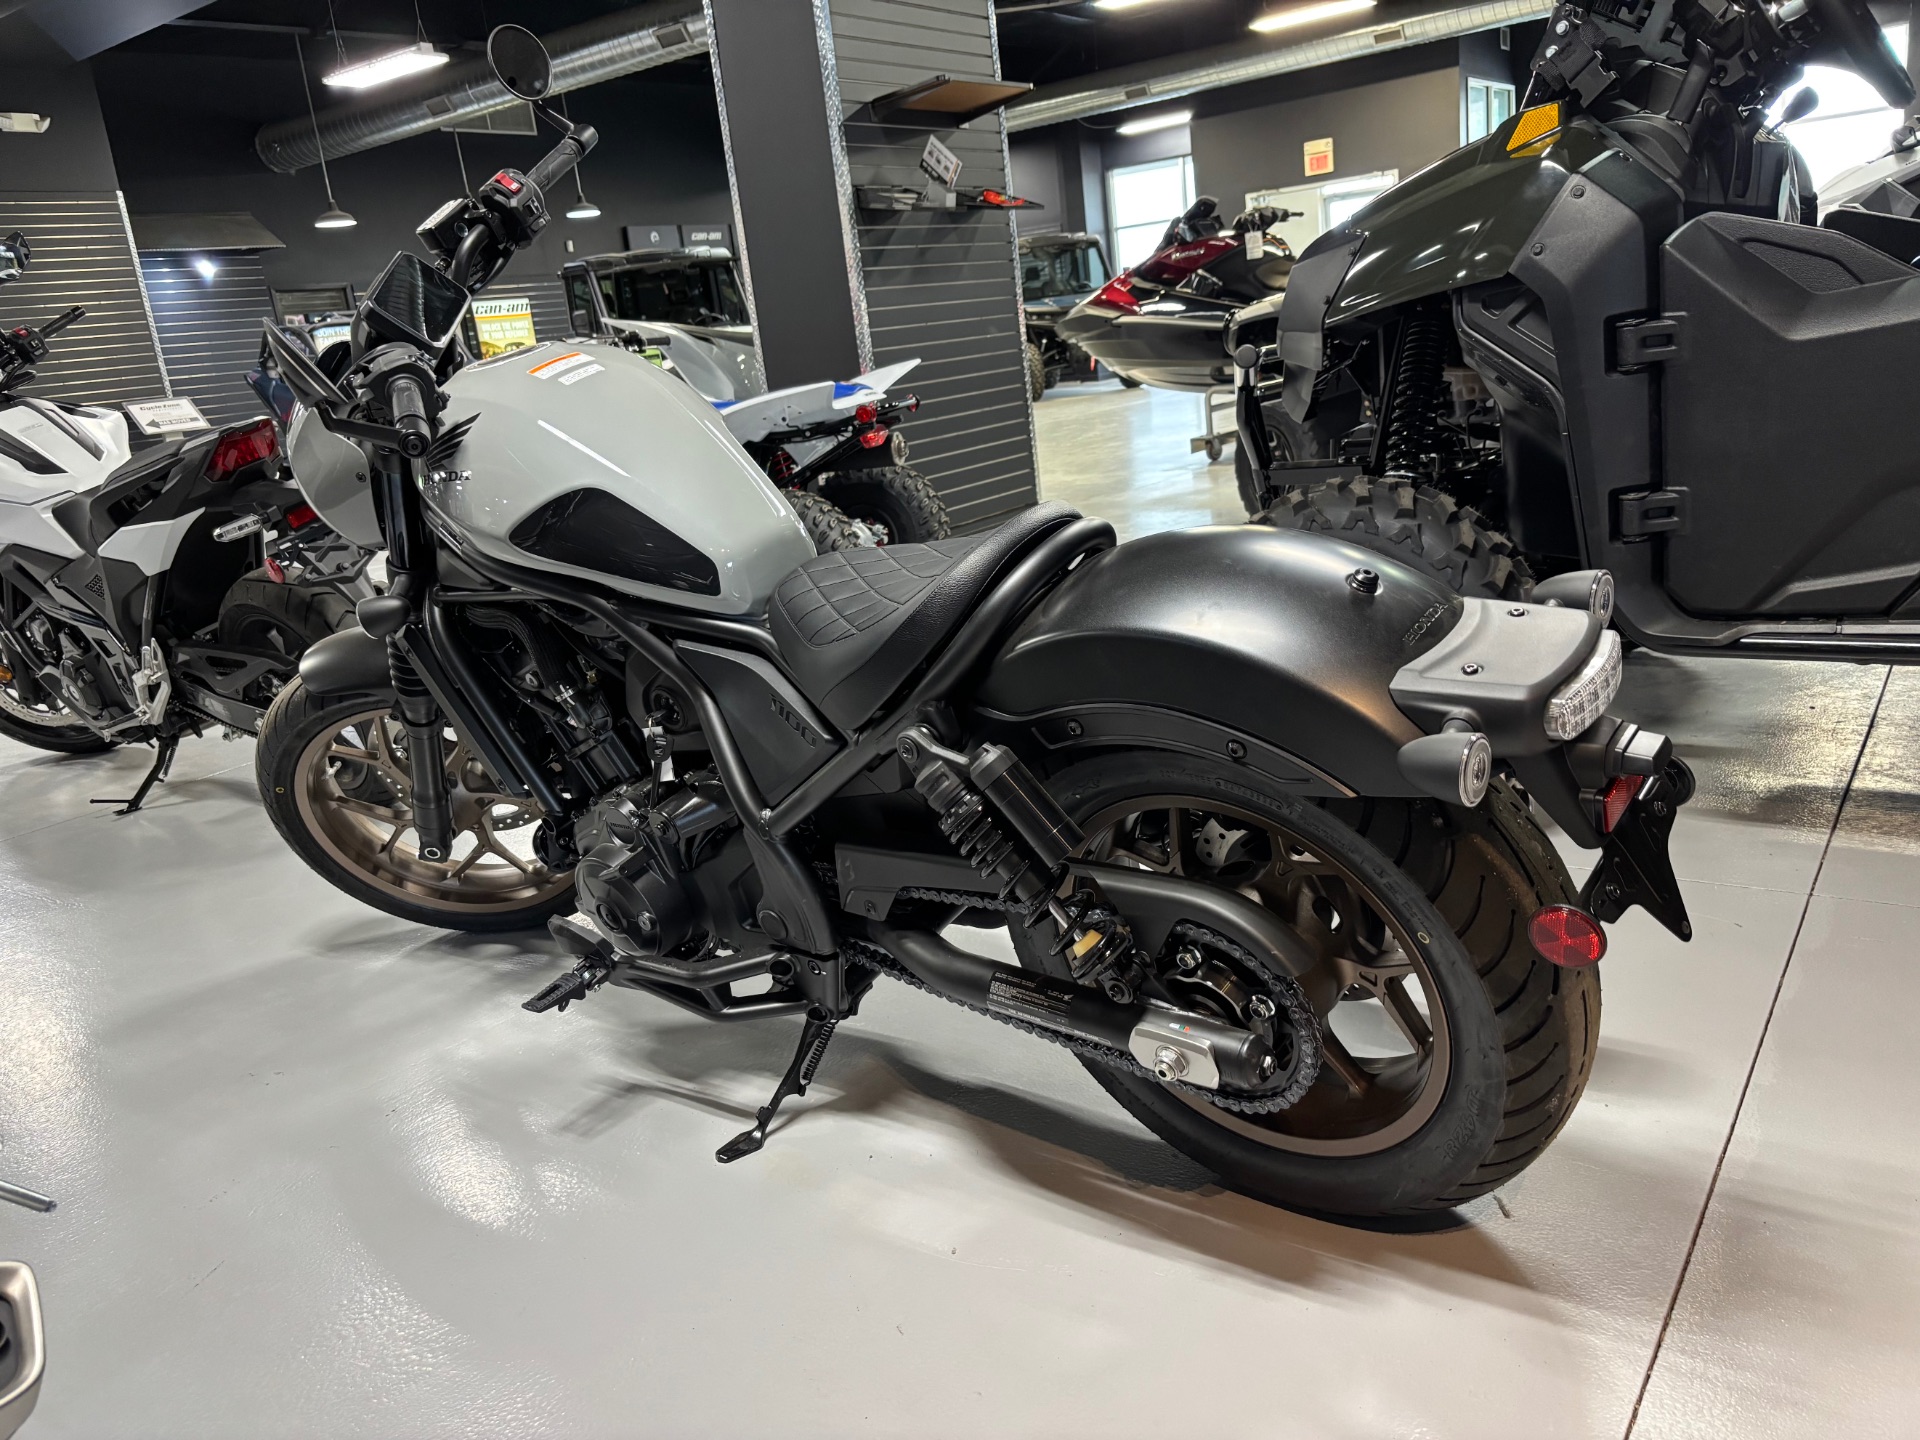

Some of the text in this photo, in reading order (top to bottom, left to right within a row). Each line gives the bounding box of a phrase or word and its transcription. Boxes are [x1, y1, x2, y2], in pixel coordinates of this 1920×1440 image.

[691, 232, 722, 241] can-am
[475, 303, 529, 315] can-am
[317, 327, 335, 337] JOIN
[1402, 602, 1449, 646] HONDA
